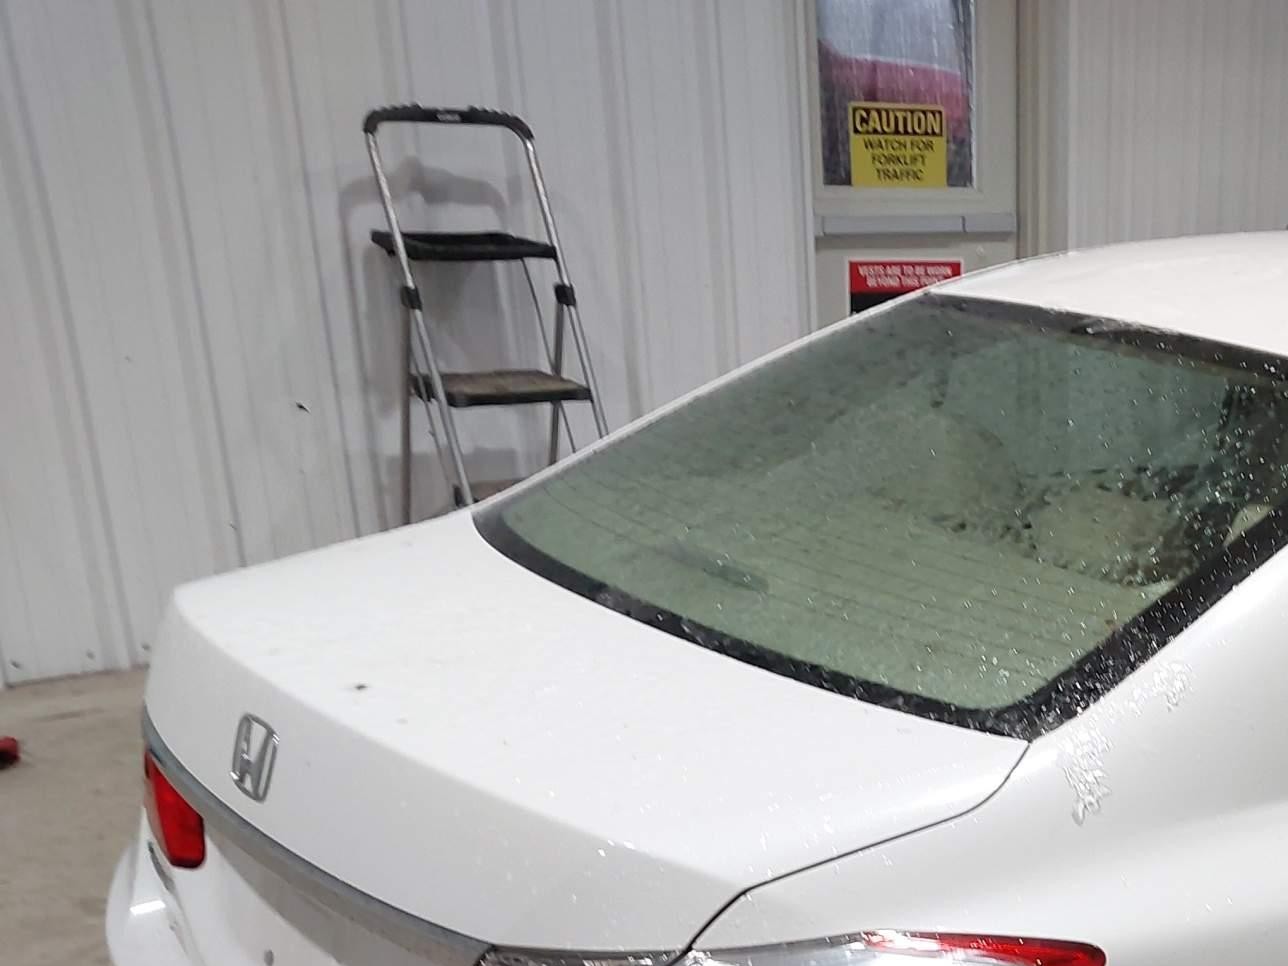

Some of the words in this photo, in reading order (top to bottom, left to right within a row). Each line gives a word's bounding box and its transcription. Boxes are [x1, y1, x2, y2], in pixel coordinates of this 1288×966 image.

[855, 110, 941, 134] CAUTION
[864, 138, 907, 152] WATCH
[910, 139, 935, 153] FOR
[871, 153, 926, 167] FORKLIFT
[876, 168, 925, 182] TRAFFIC
